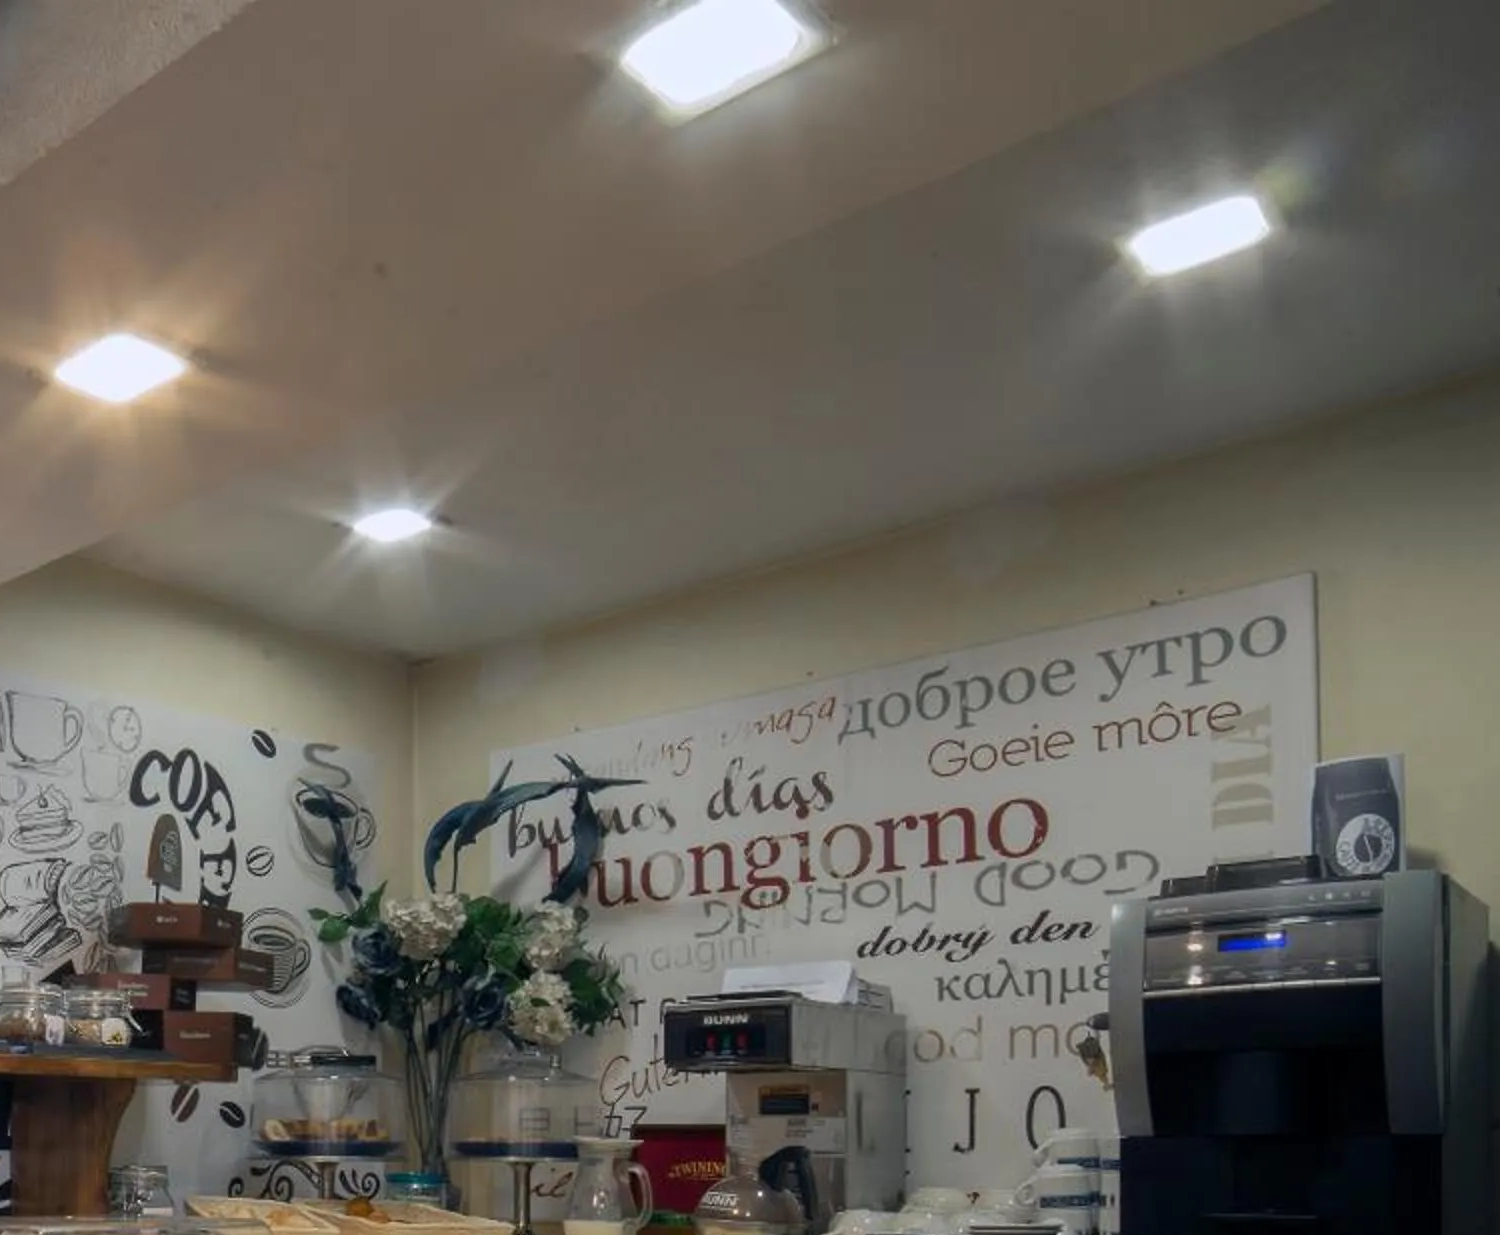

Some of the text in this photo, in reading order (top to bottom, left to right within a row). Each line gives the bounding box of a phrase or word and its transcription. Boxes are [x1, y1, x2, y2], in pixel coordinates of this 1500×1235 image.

[838, 613, 1288, 746] доброе утро
[927, 699, 1243, 778] Goeie môre
[129, 747, 237, 911] COFF
[508, 756, 835, 859] bunos días
[856, 908, 1102, 963] dobrý den
[934, 949, 1109, 1007] καλημέ
[702, 1012, 750, 1025] BUNN
[672, 1159, 726, 1178] TWININ
